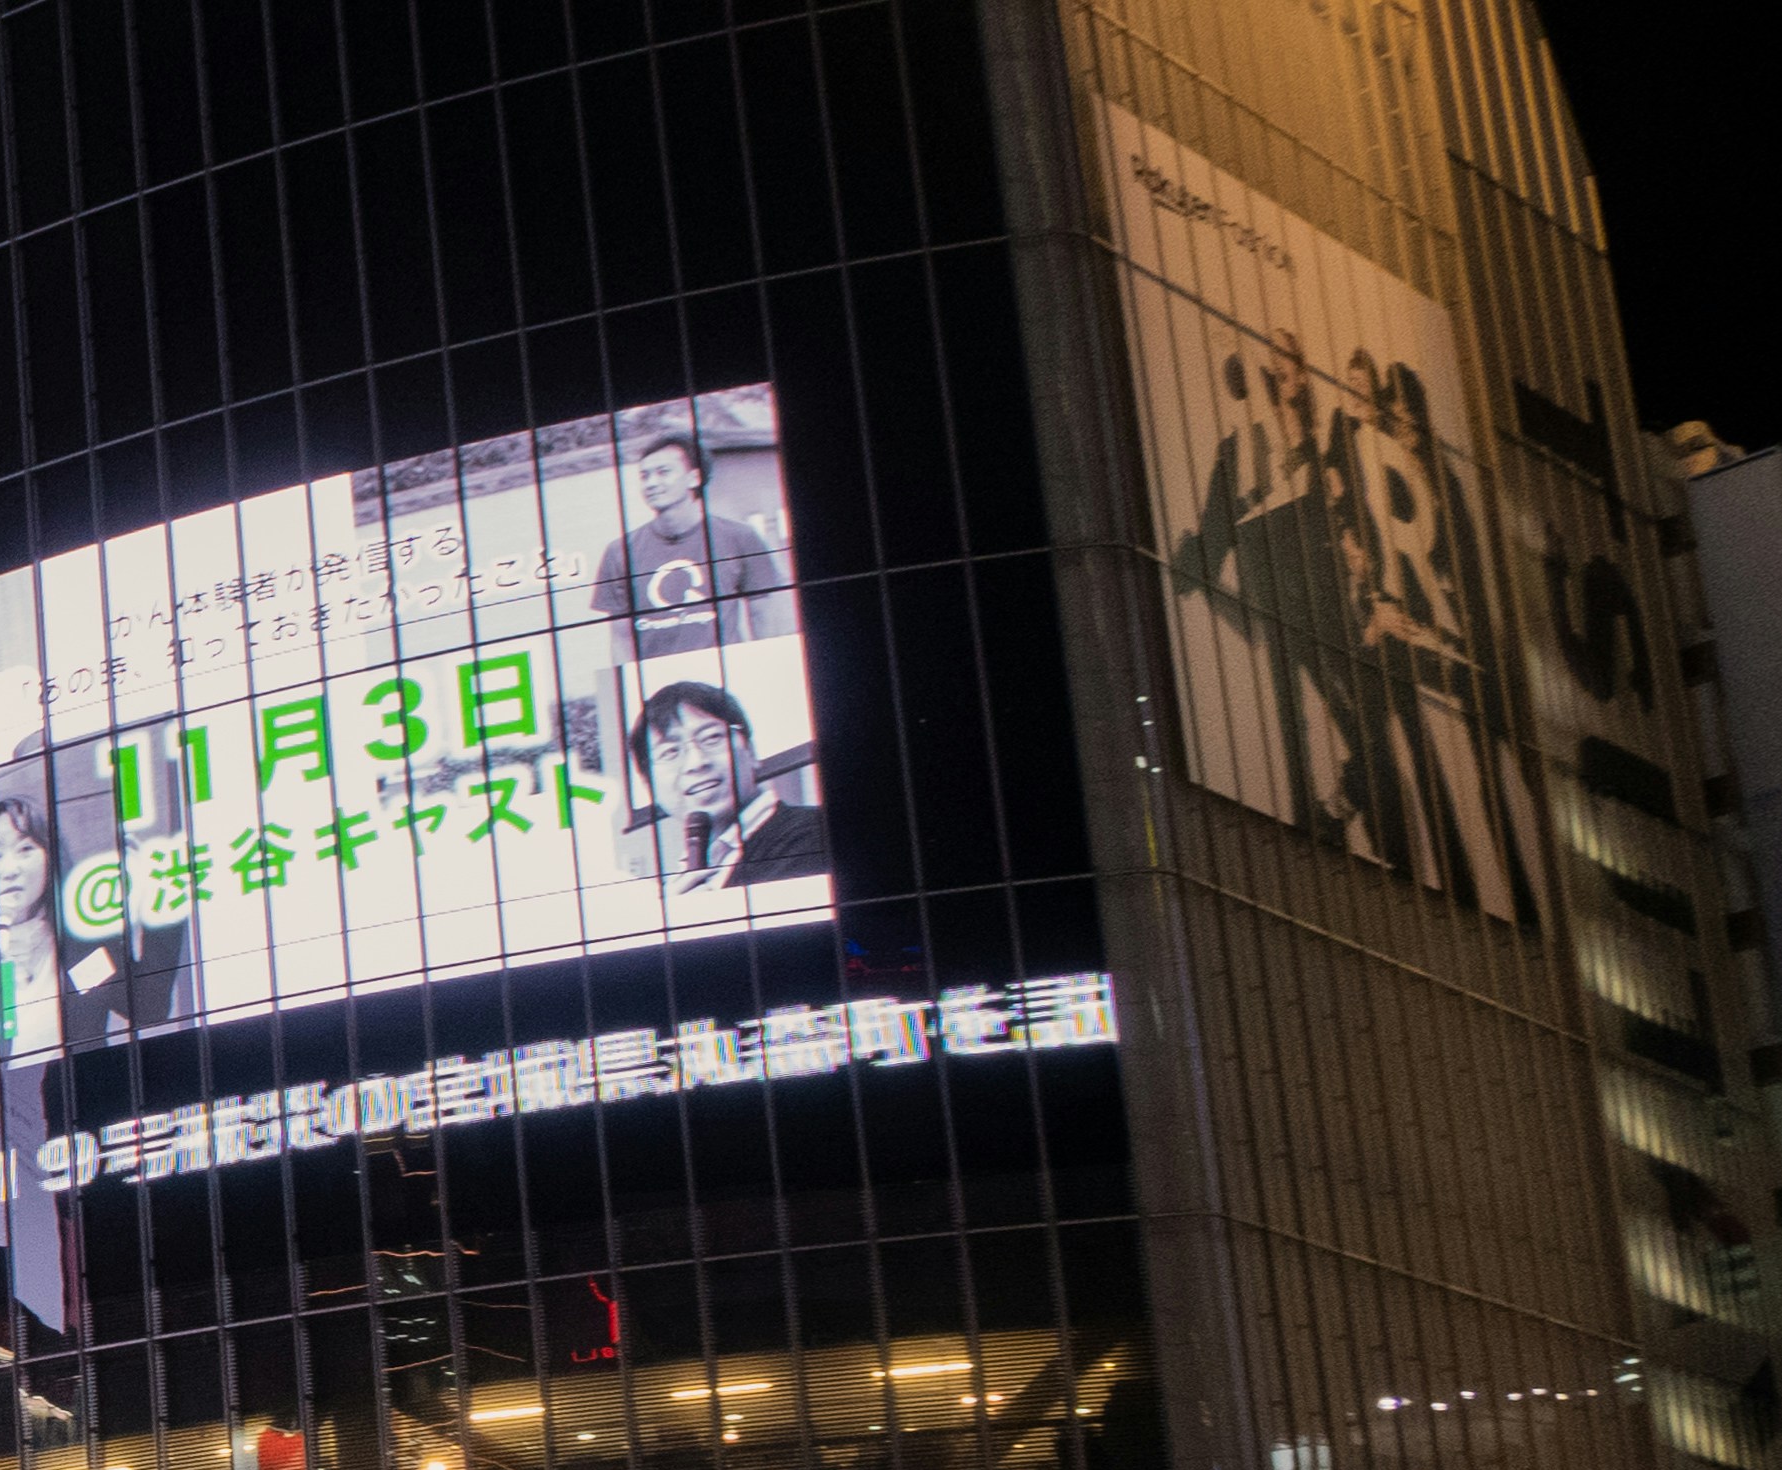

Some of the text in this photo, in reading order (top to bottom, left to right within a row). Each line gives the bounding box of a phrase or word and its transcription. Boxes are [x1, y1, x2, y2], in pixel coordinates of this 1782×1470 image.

[108, 648, 539, 823] 11月3日
[70, 760, 609, 936] @渋谷キャスト
